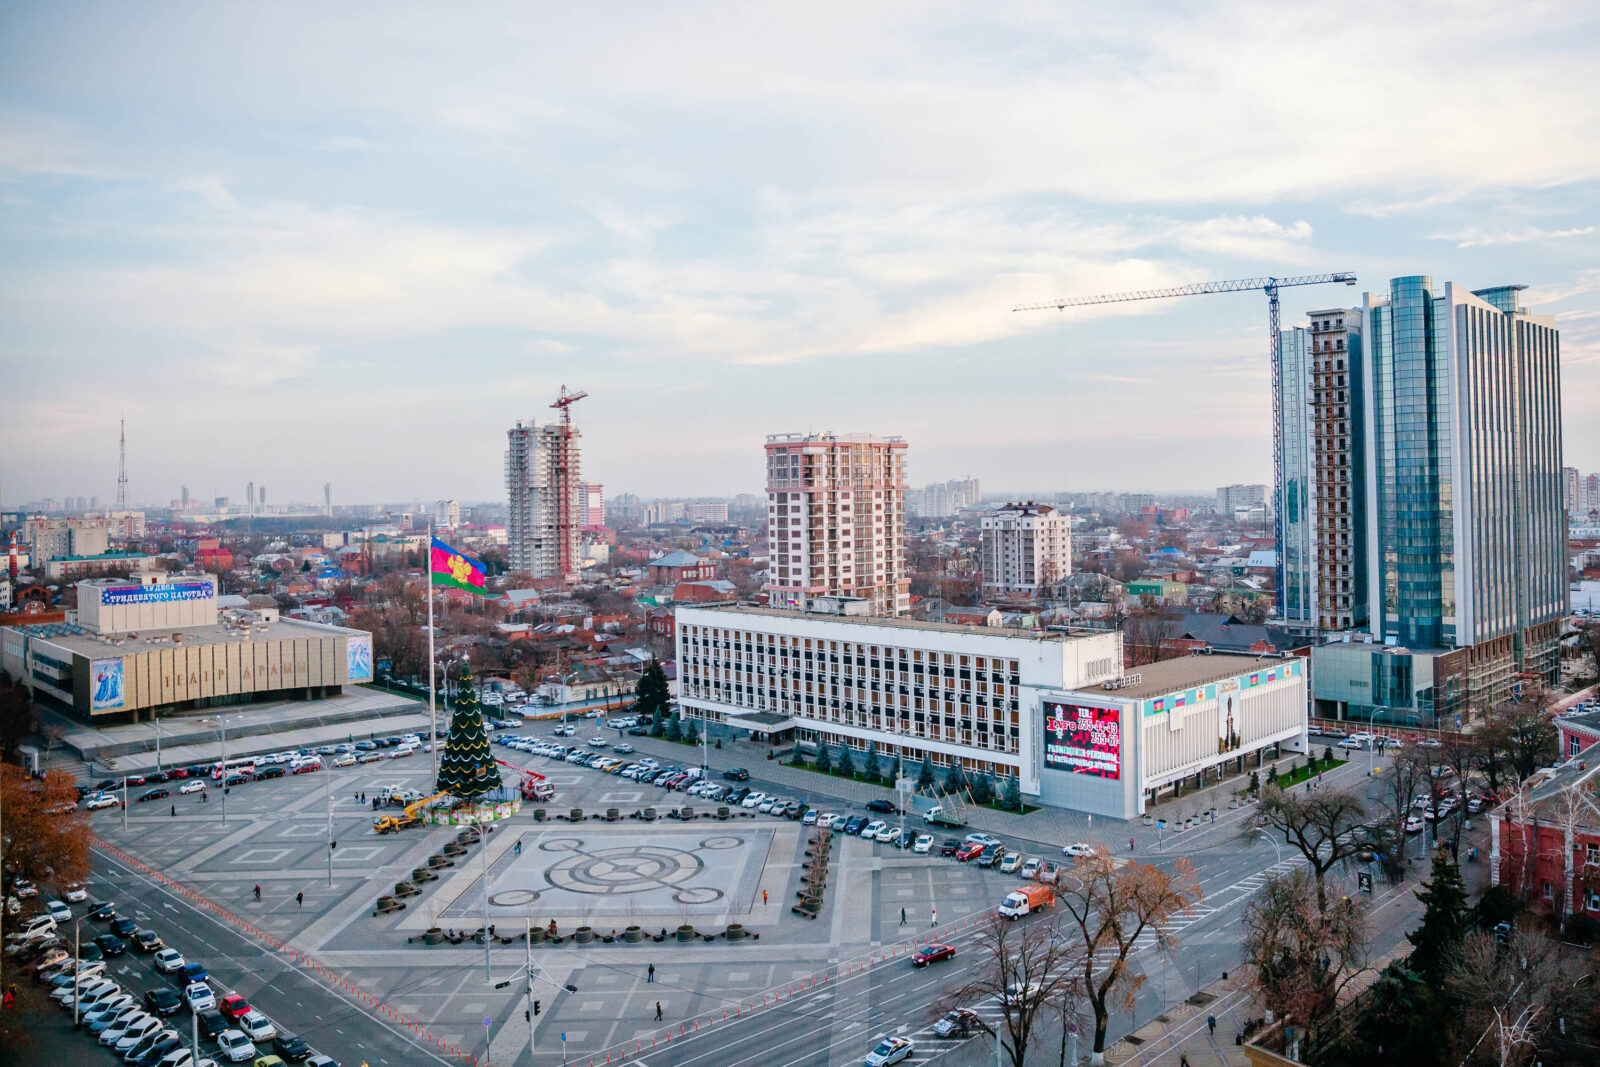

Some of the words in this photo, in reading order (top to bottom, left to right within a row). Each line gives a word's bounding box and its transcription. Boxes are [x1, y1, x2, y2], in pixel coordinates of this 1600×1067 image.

[143, 584, 175, 592] ЧУДЕСА
[109, 592, 169, 603] ТРИДЕВЯТОГО
[170, 590, 207, 599] ЦАРСТВА
[164, 669, 225, 688] ТЕАТР
[243, 661, 306, 679] ДРАМЫ
